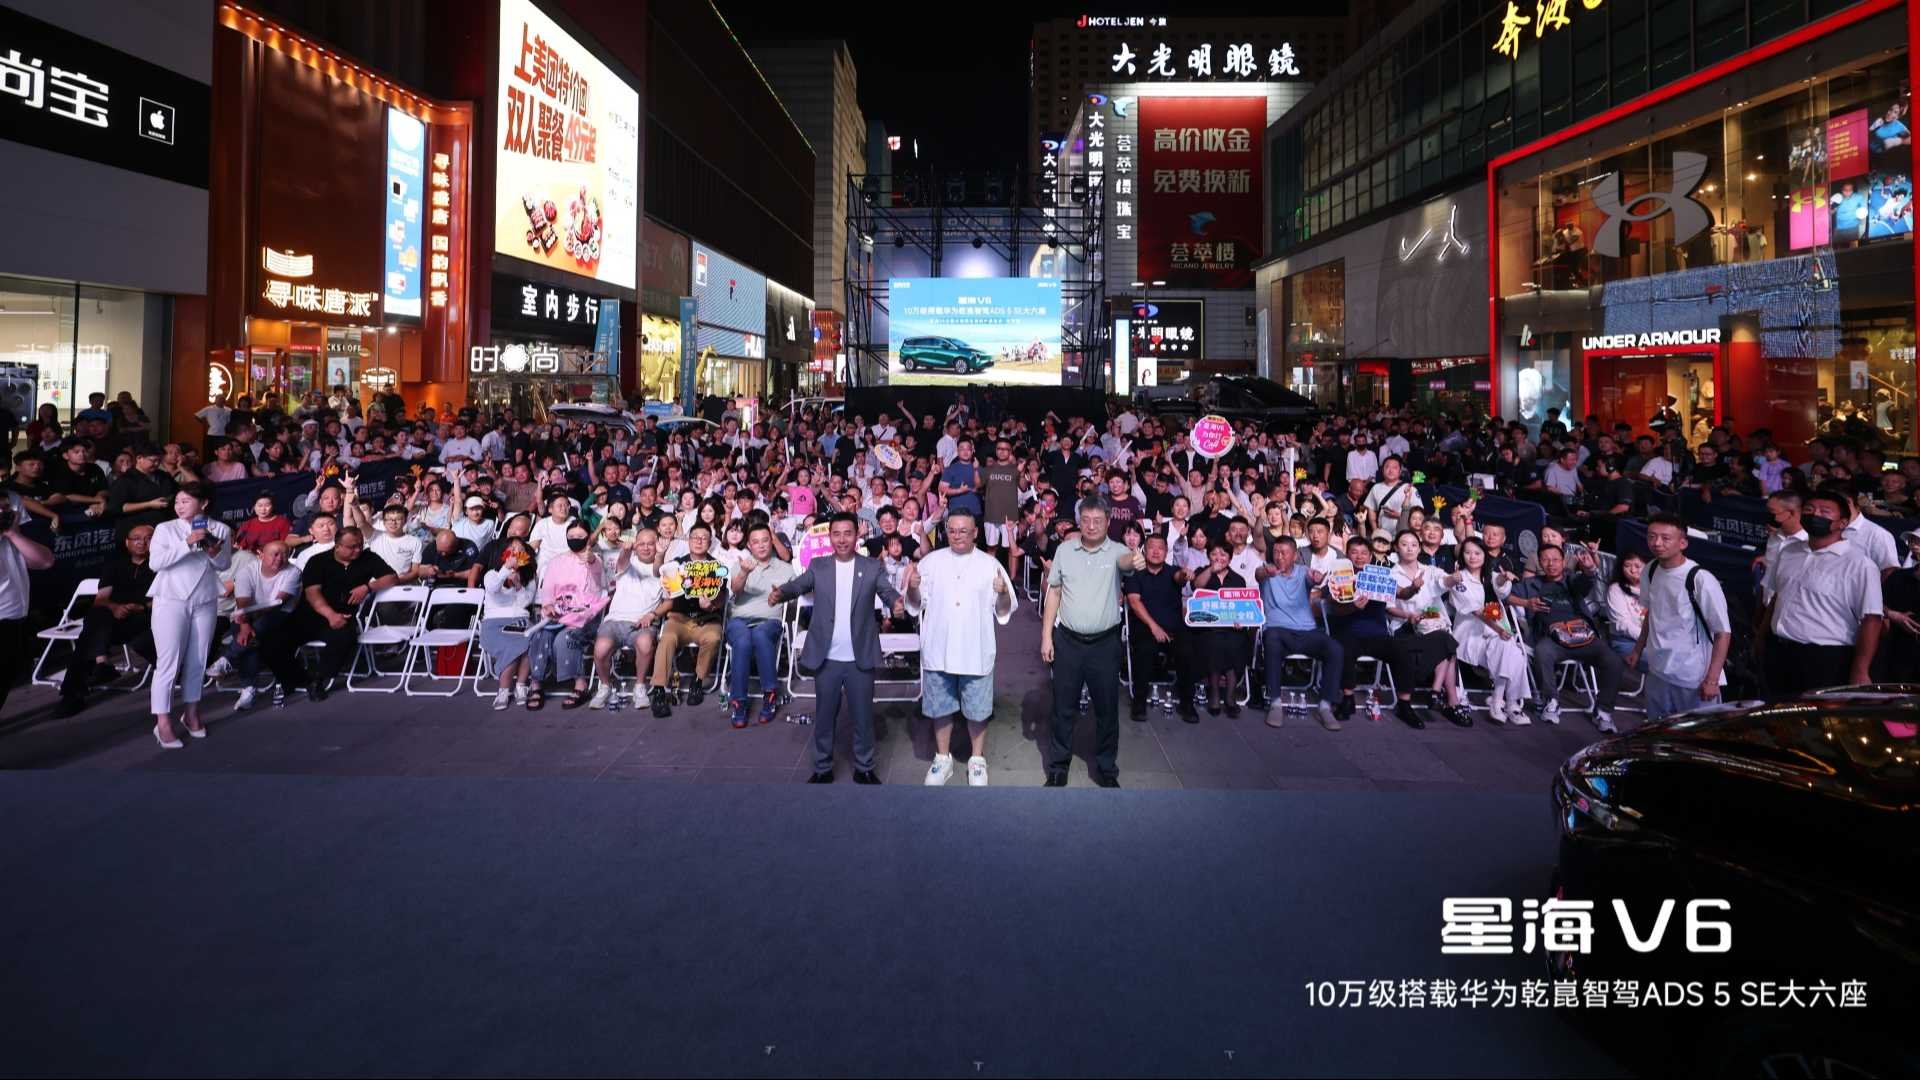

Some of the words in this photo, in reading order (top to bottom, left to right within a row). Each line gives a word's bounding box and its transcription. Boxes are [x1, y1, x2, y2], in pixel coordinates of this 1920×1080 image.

[1089, 16, 1122, 27] HOTEL
[1123, 16, 1144, 27] JEN
[1154, 128, 1251, 152] 高价收金
[1153, 169, 1250, 193] 免费换新
[1171, 243, 1235, 262] 荟萃楼
[262, 279, 371, 317] 寻味唐派
[521, 284, 599, 325] 室内步行
[1582, 334, 1635, 350] UNDER
[1638, 328, 1720, 347] ARMOUR
[989, 474, 1012, 482] GUCCI
